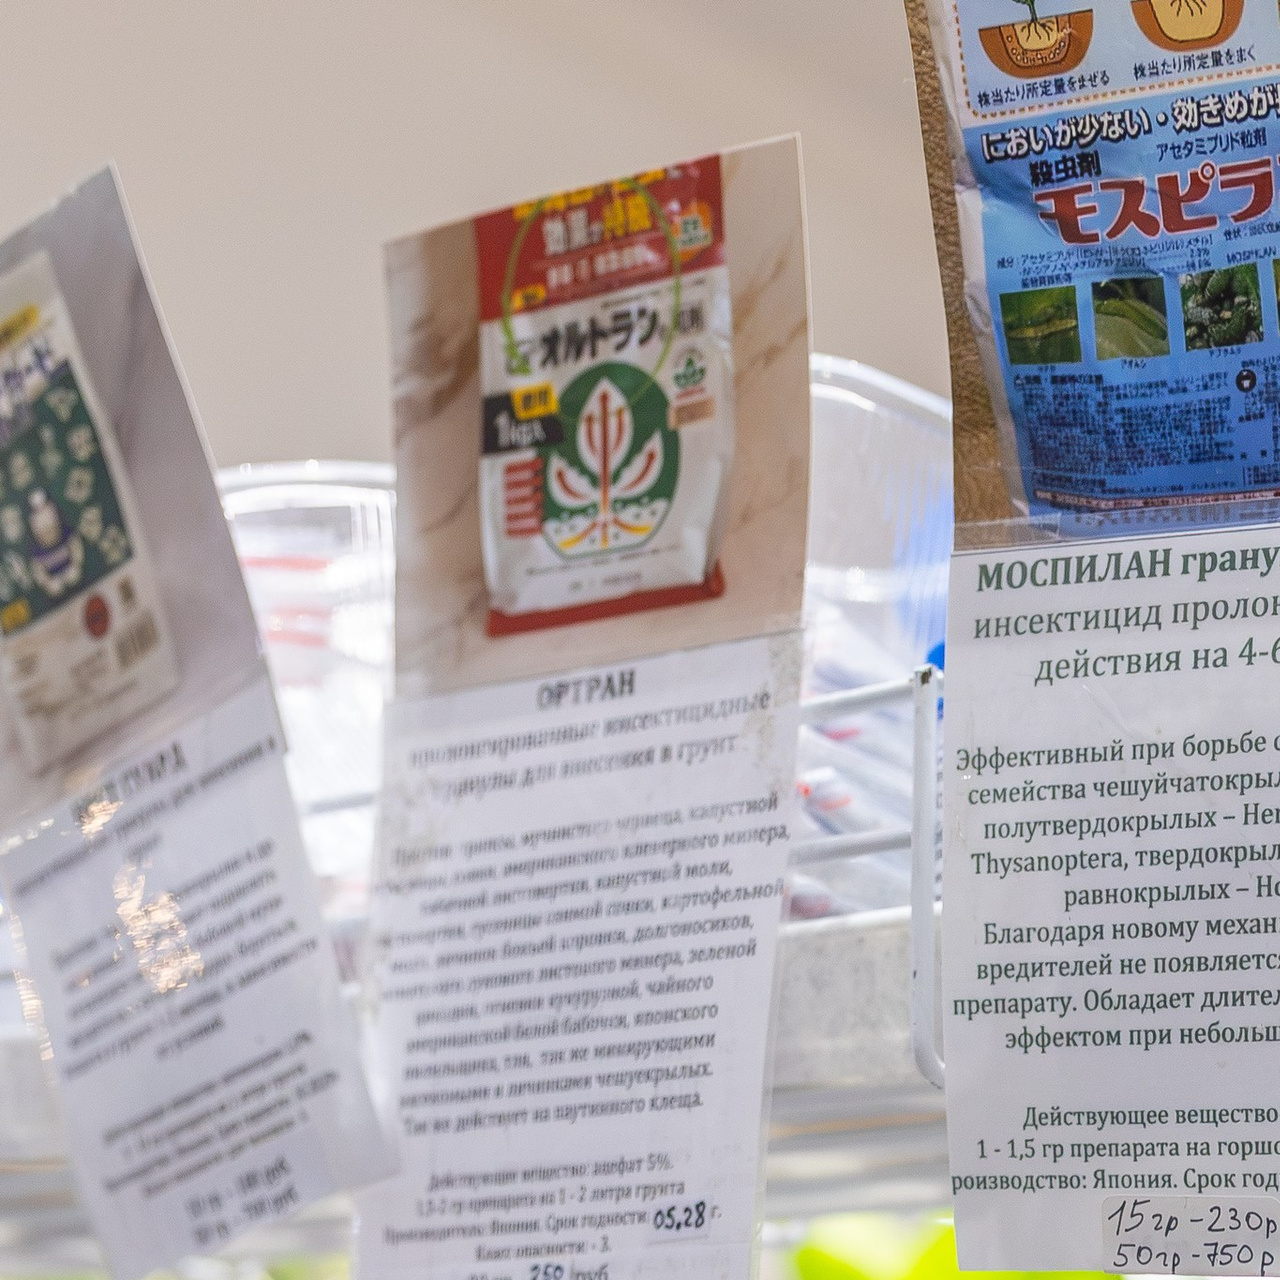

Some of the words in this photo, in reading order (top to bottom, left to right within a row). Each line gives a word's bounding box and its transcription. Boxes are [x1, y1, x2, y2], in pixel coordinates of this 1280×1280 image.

[977, 548, 1172, 592] МОСПИЛАН
[974, 604, 1162, 639] инсектицид
[1034, 648, 1181, 687] действия
[1192, 647, 1228, 670] на
[956, 738, 1124, 776] Эффективный
[1132, 741, 1175, 766] при
[1182, 730, 1267, 762] борьбе
[977, 953, 1112, 986] вредителей
[1120, 958, 1146, 975] не
[1005, 1025, 1121, 1054] эффектом
[1129, 1028, 1172, 1052] при
[1093, 1168, 1178, 1189] Япония.
[1183, 1167, 1236, 1195] Срок
